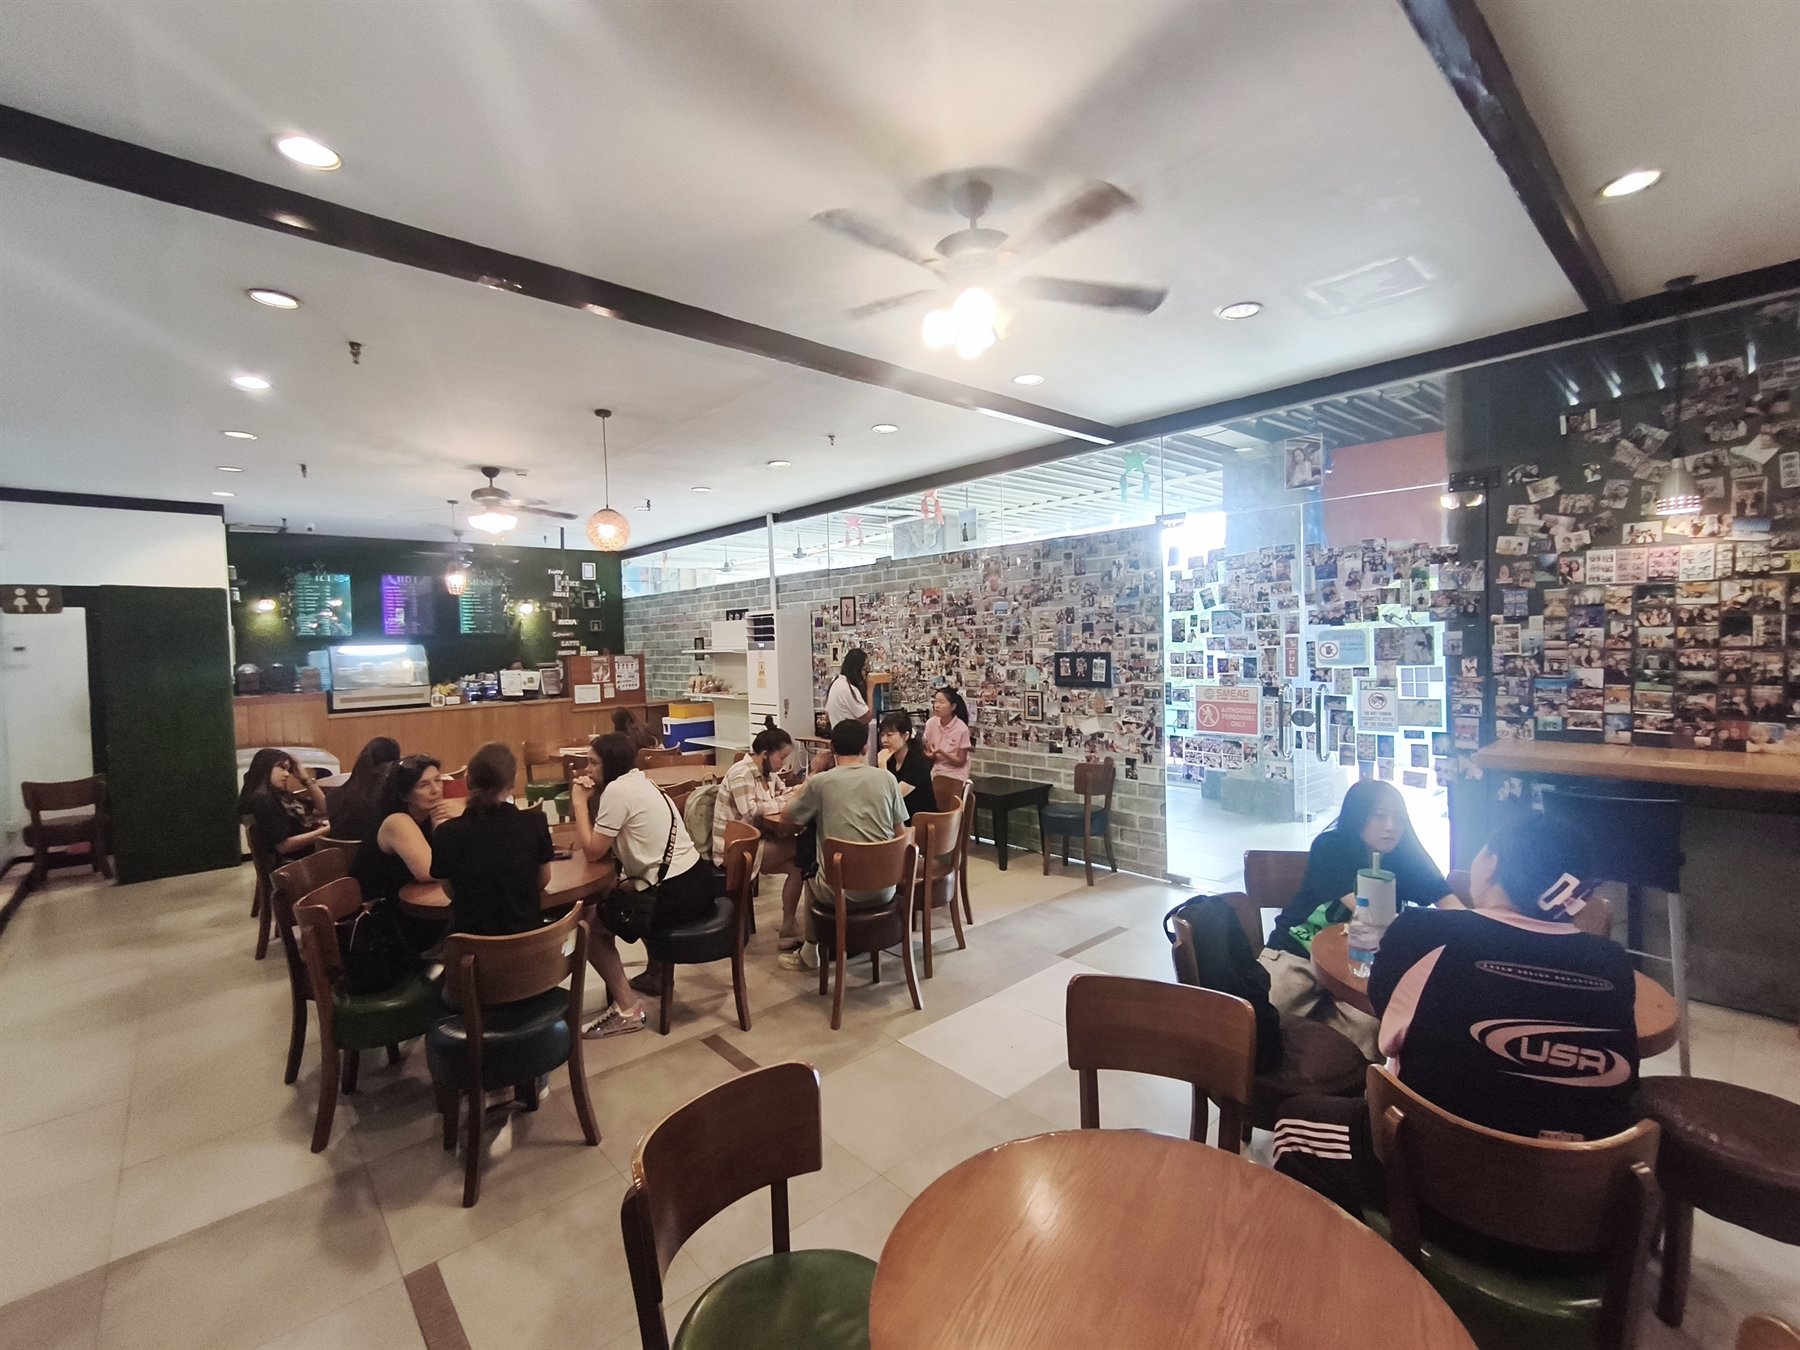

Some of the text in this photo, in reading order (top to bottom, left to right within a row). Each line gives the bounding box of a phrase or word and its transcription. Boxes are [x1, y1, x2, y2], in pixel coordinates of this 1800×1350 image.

[1288, 650, 1297, 676] PULL
[1216, 689, 1249, 698] SMEAG
[1220, 706, 1257, 715] AUTHORIZED
[1221, 713, 1256, 721] PERSONNEL
[1230, 720, 1247, 728] ONLY
[1520, 1036, 1607, 1075] USA
